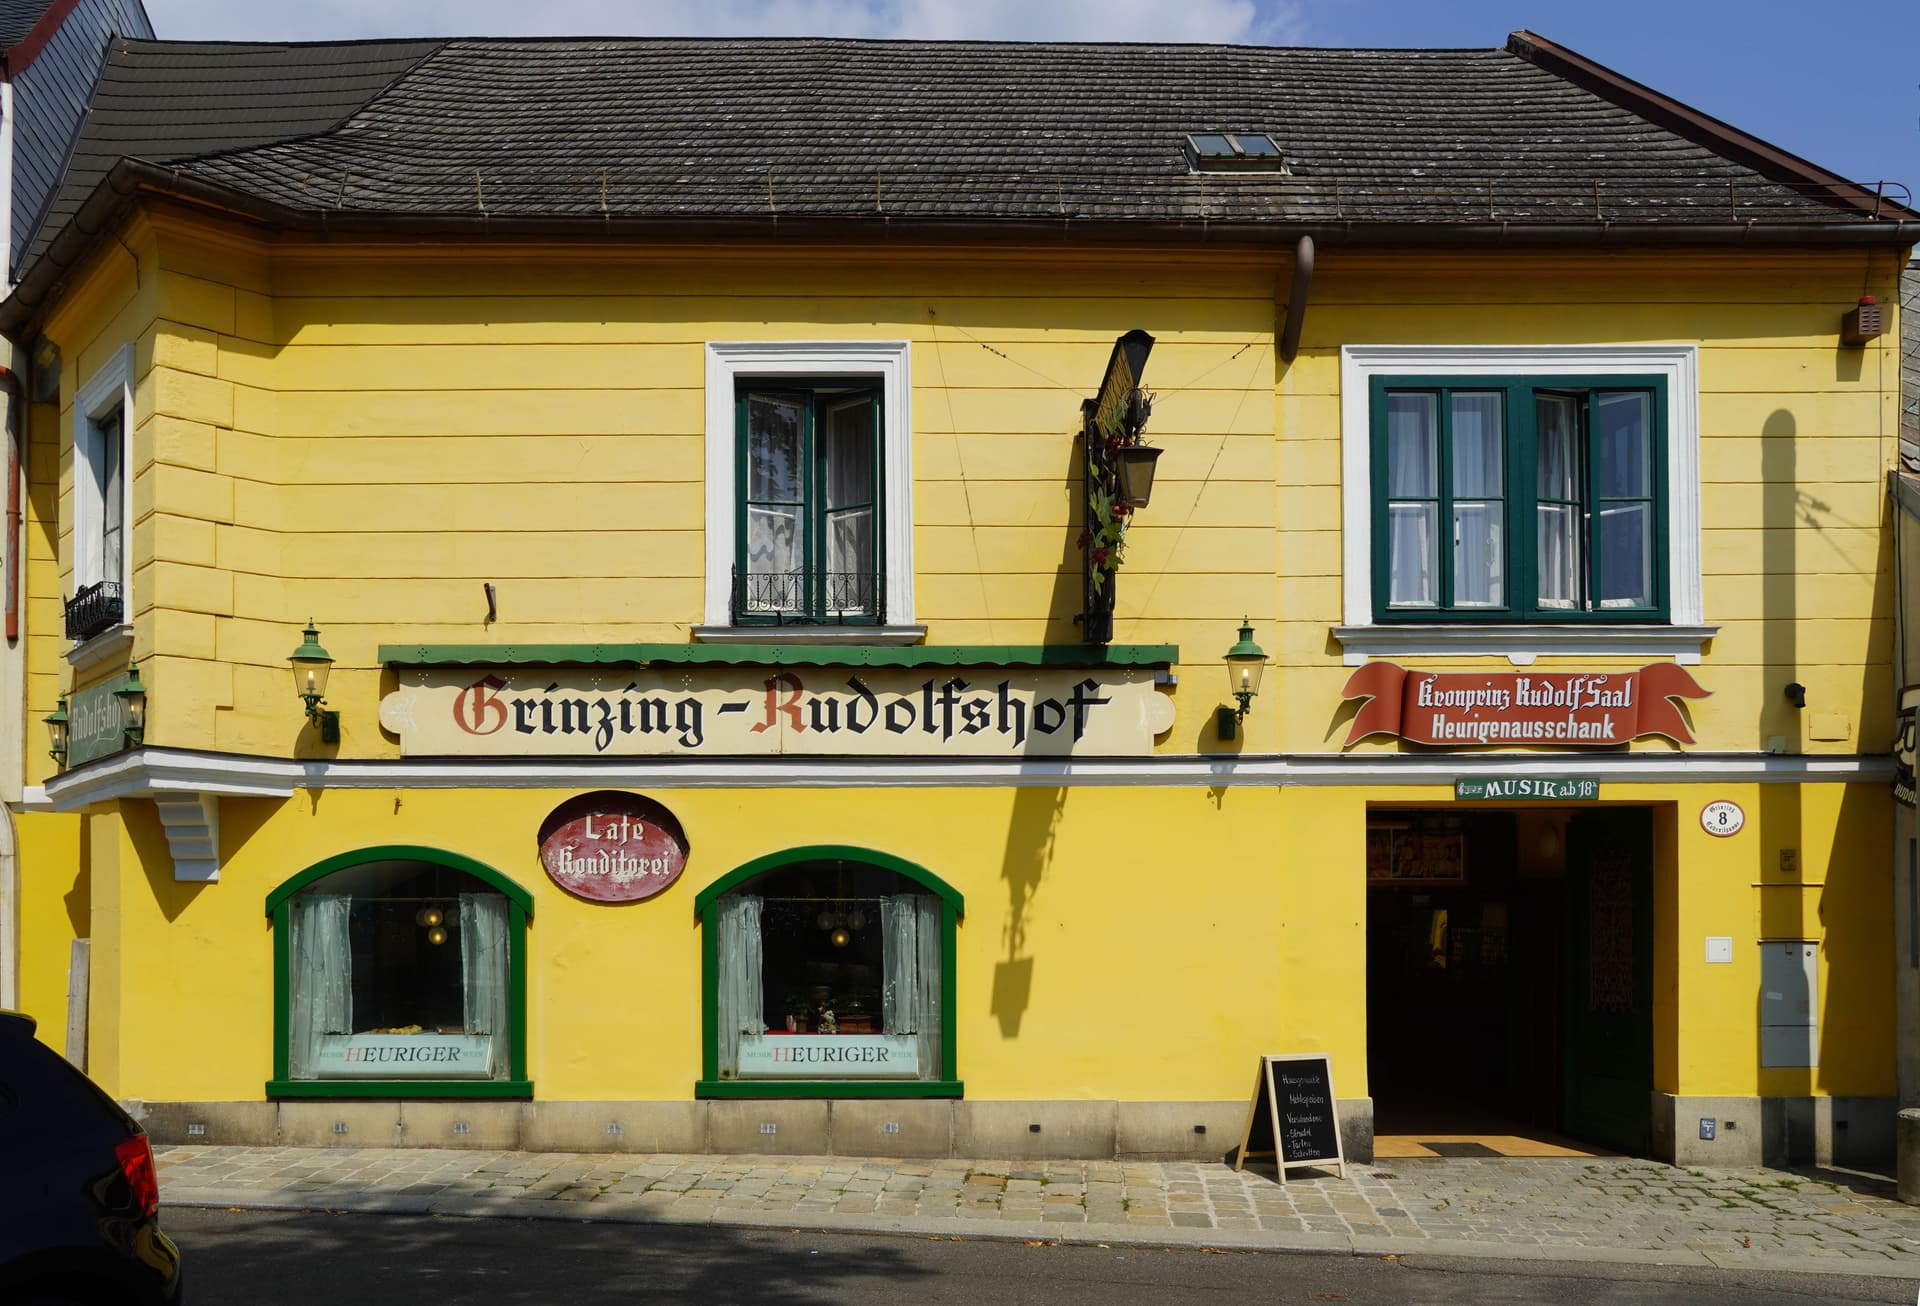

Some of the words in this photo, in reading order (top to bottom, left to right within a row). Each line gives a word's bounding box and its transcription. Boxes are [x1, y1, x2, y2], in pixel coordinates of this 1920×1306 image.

[1417, 674, 1511, 715] Kronprinz
[1432, 713, 1616, 744] Heurigenausschank
[1483, 779, 1557, 799] MUSIK
[1560, 781, 1576, 796] ab
[1718, 811, 1728, 826] 8
[558, 838, 670, 876] Konditorei
[344, 1047, 461, 1063] HEURIGER
[773, 1047, 889, 1063] HEURIGER
